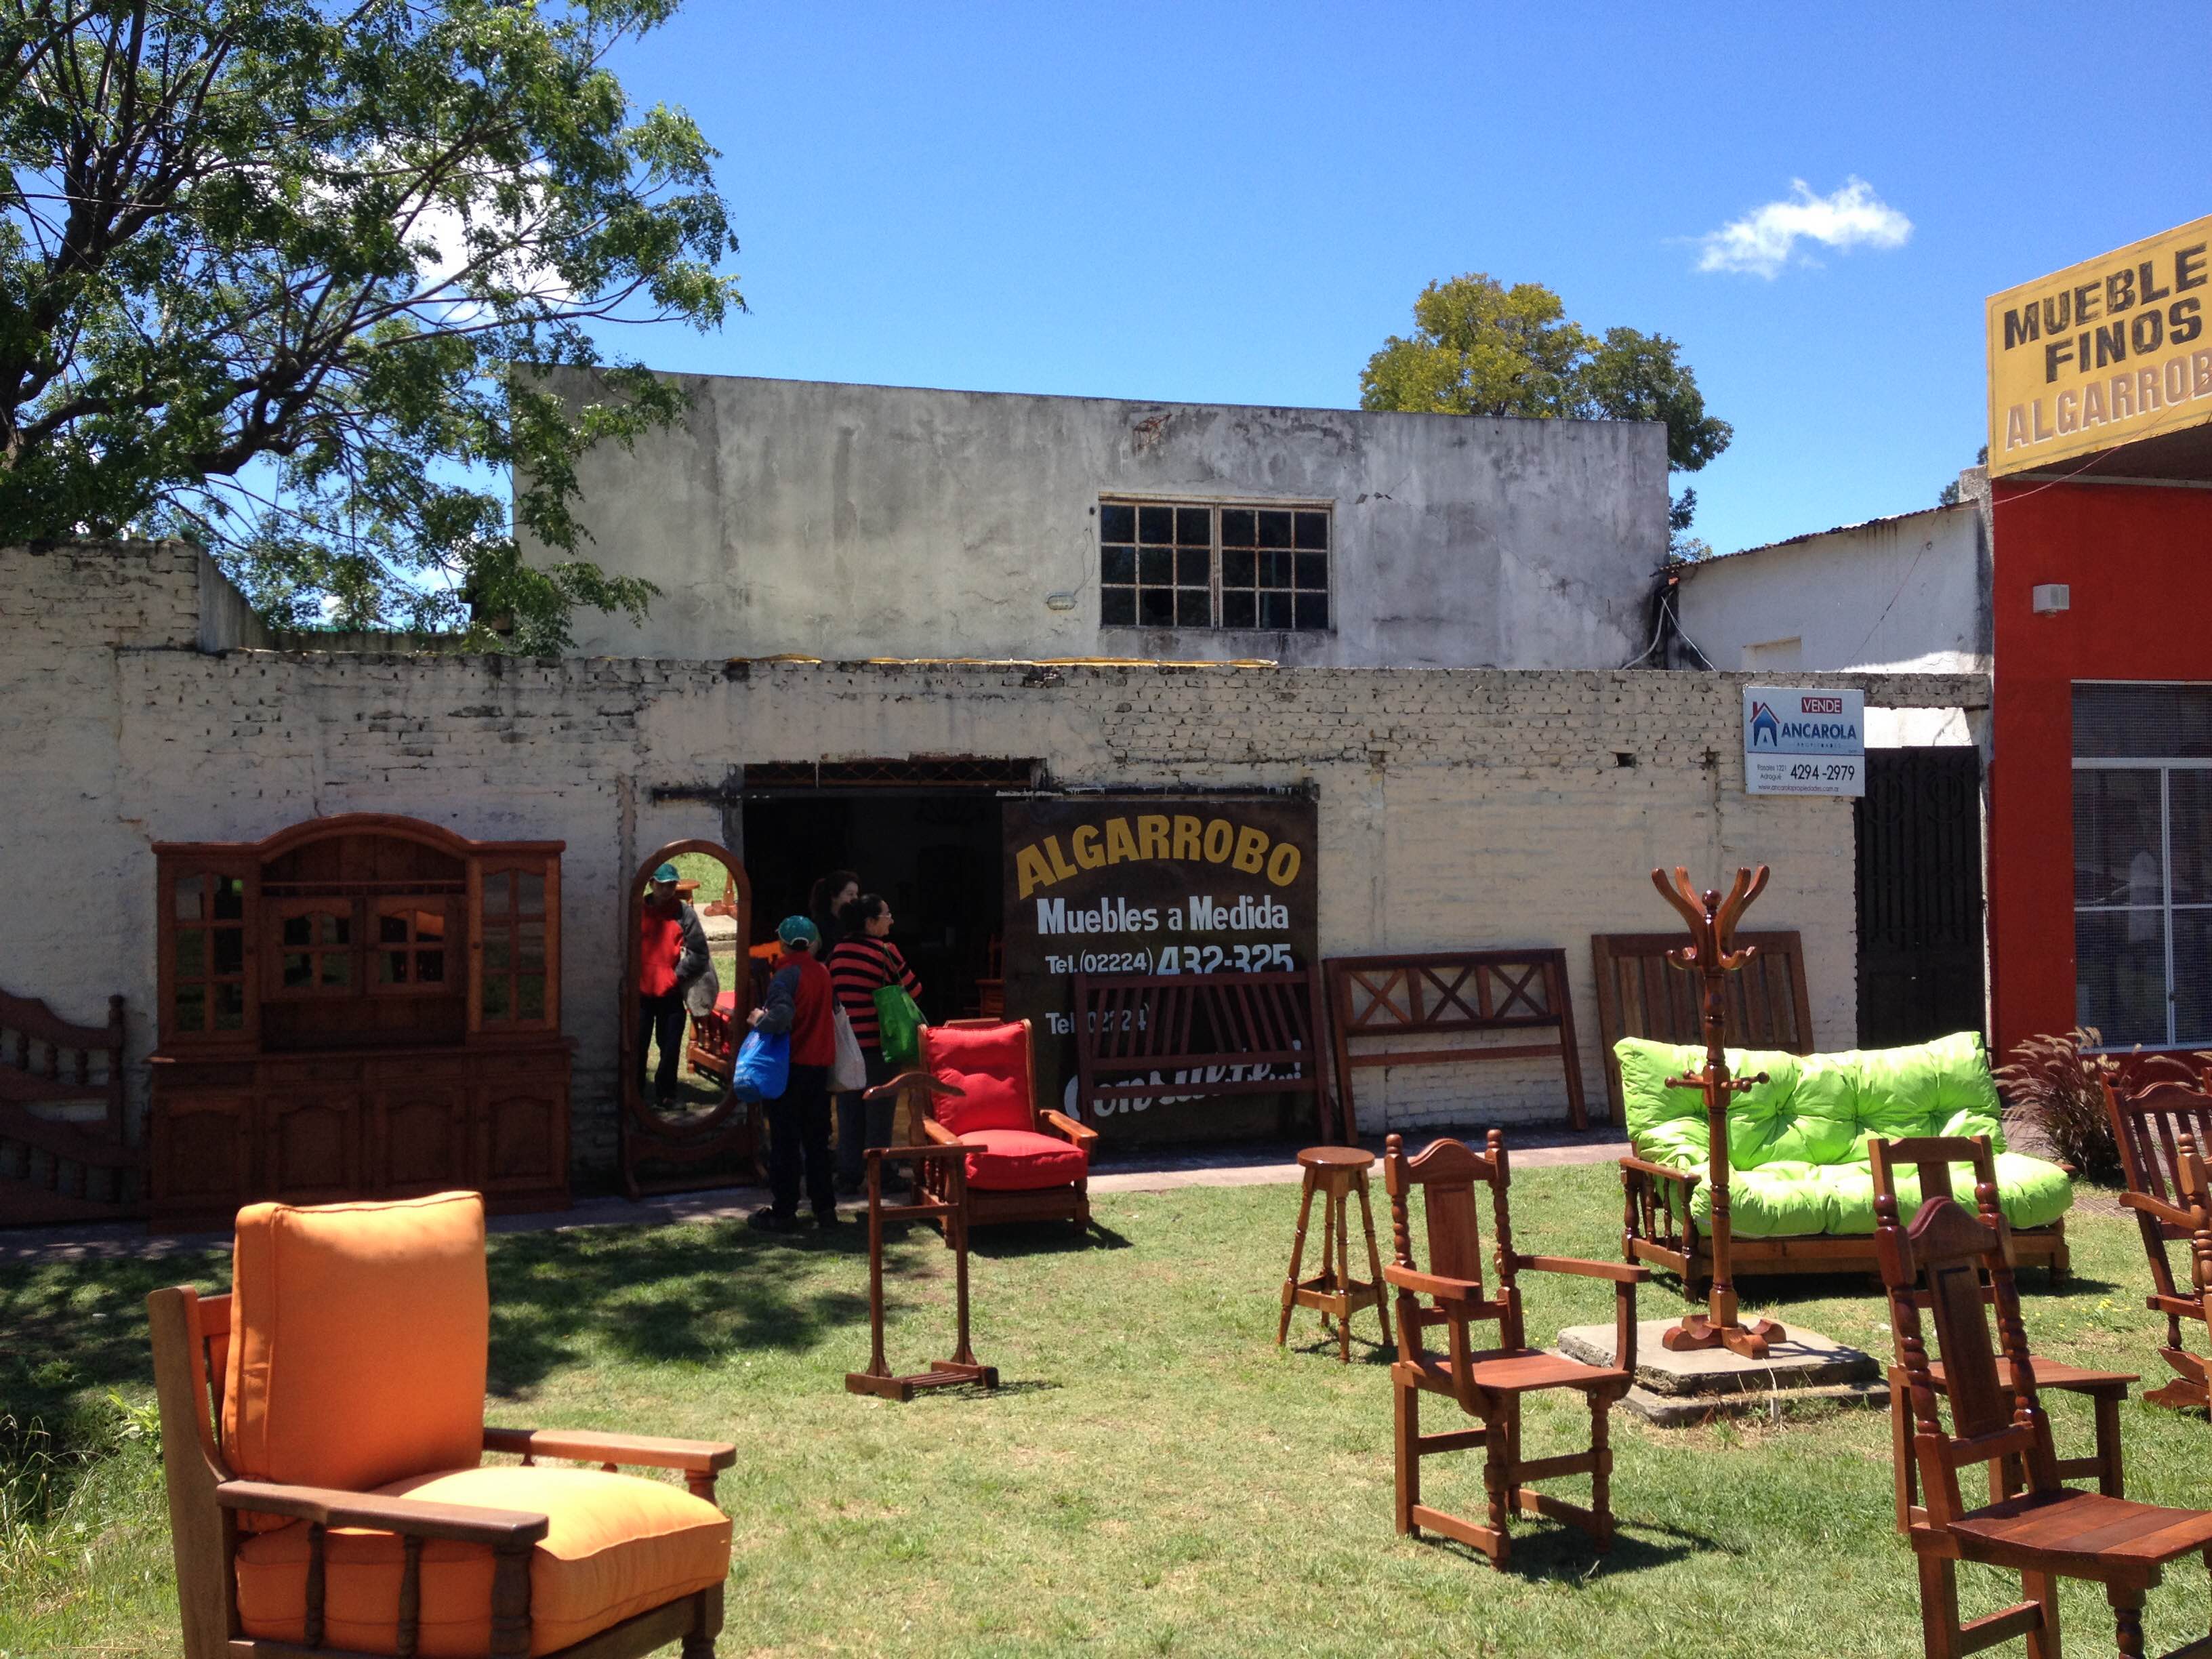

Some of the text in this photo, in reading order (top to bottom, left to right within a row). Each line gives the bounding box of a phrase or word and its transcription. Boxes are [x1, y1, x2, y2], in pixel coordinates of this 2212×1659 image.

[2004, 241, 2208, 350] MUEBLE
[2045, 296, 2203, 384] FINOS
[2005, 347, 2212, 452] ALGARROB
[1781, 722, 1857, 740] ANCAROLA
[1803, 699, 1841, 713] VENDE
[1017, 815, 1301, 900] ALGARROBO
[1037, 895, 1289, 935] Muebles a Medida
